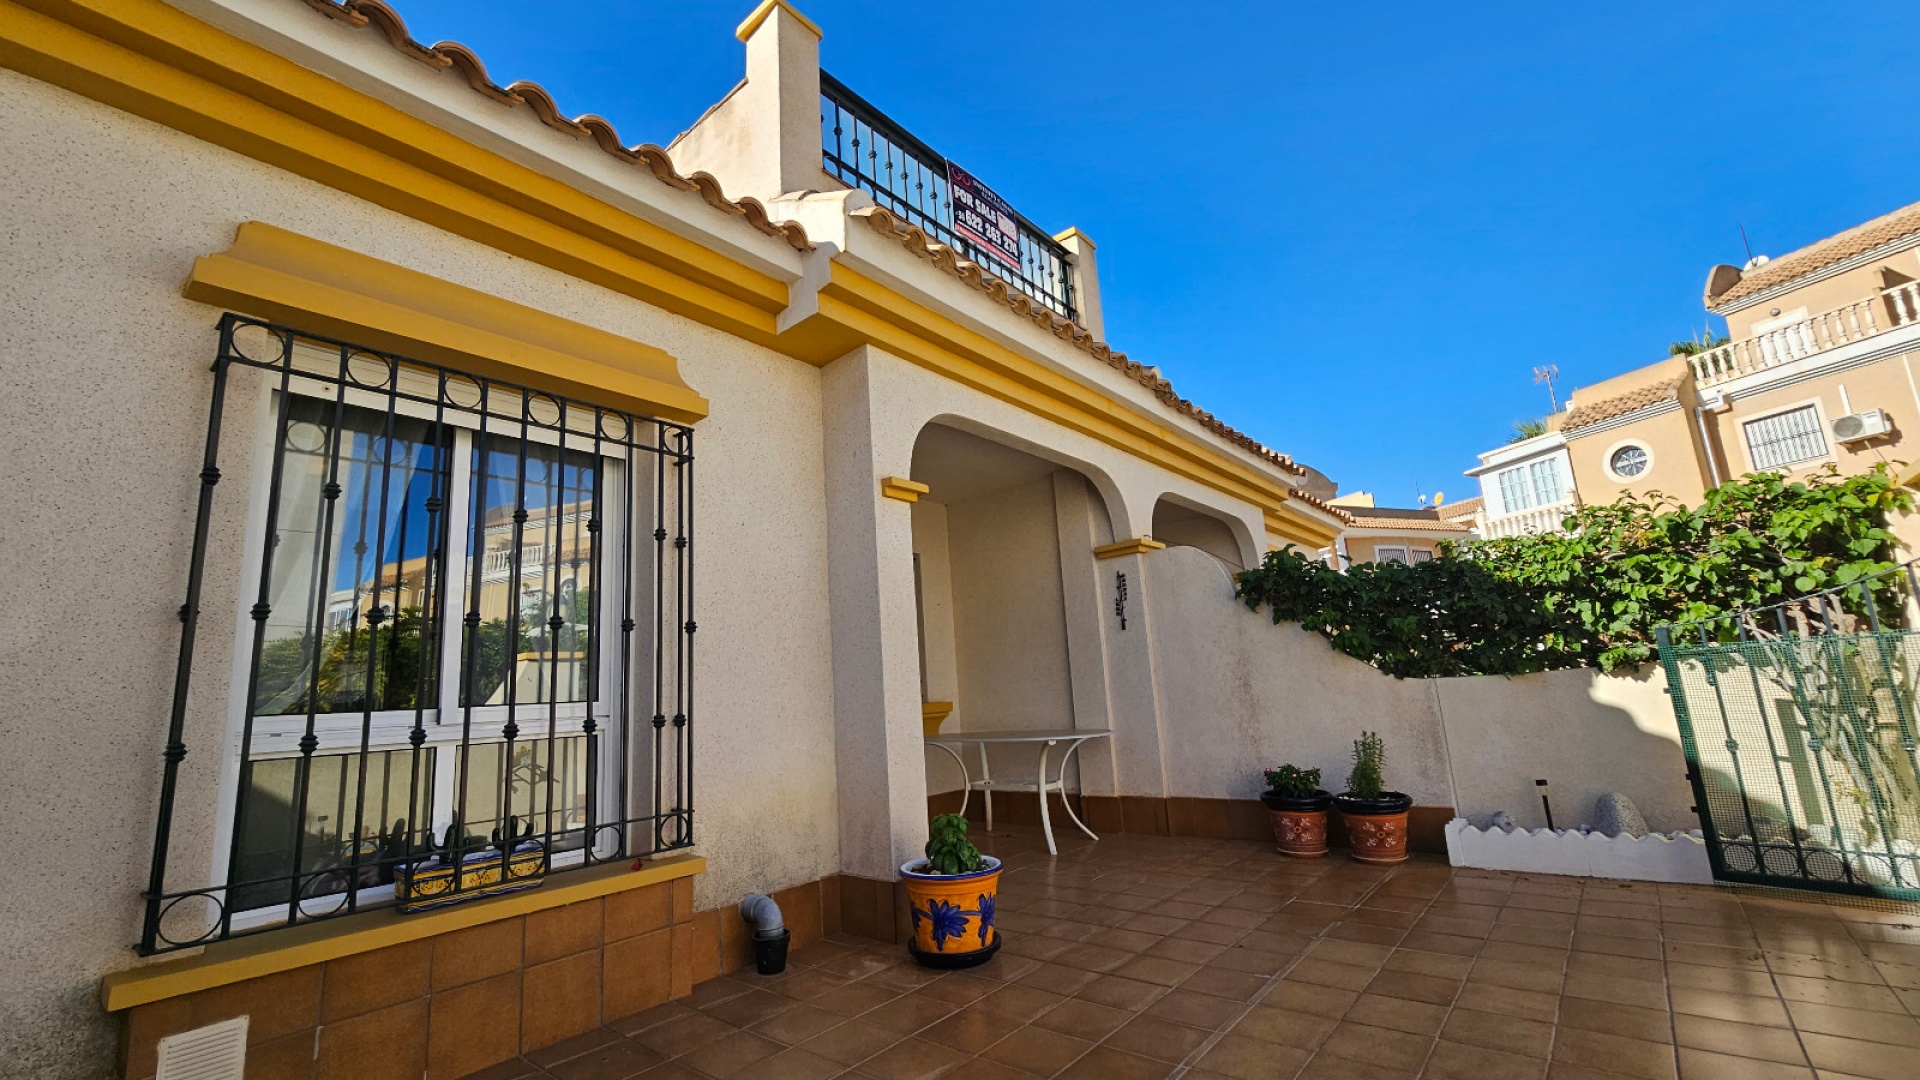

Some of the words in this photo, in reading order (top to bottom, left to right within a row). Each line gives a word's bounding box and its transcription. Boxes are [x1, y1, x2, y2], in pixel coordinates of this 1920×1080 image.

[953, 184, 973, 209] FOR
[975, 198, 997, 224] SALE
[965, 209, 984, 233] 622
